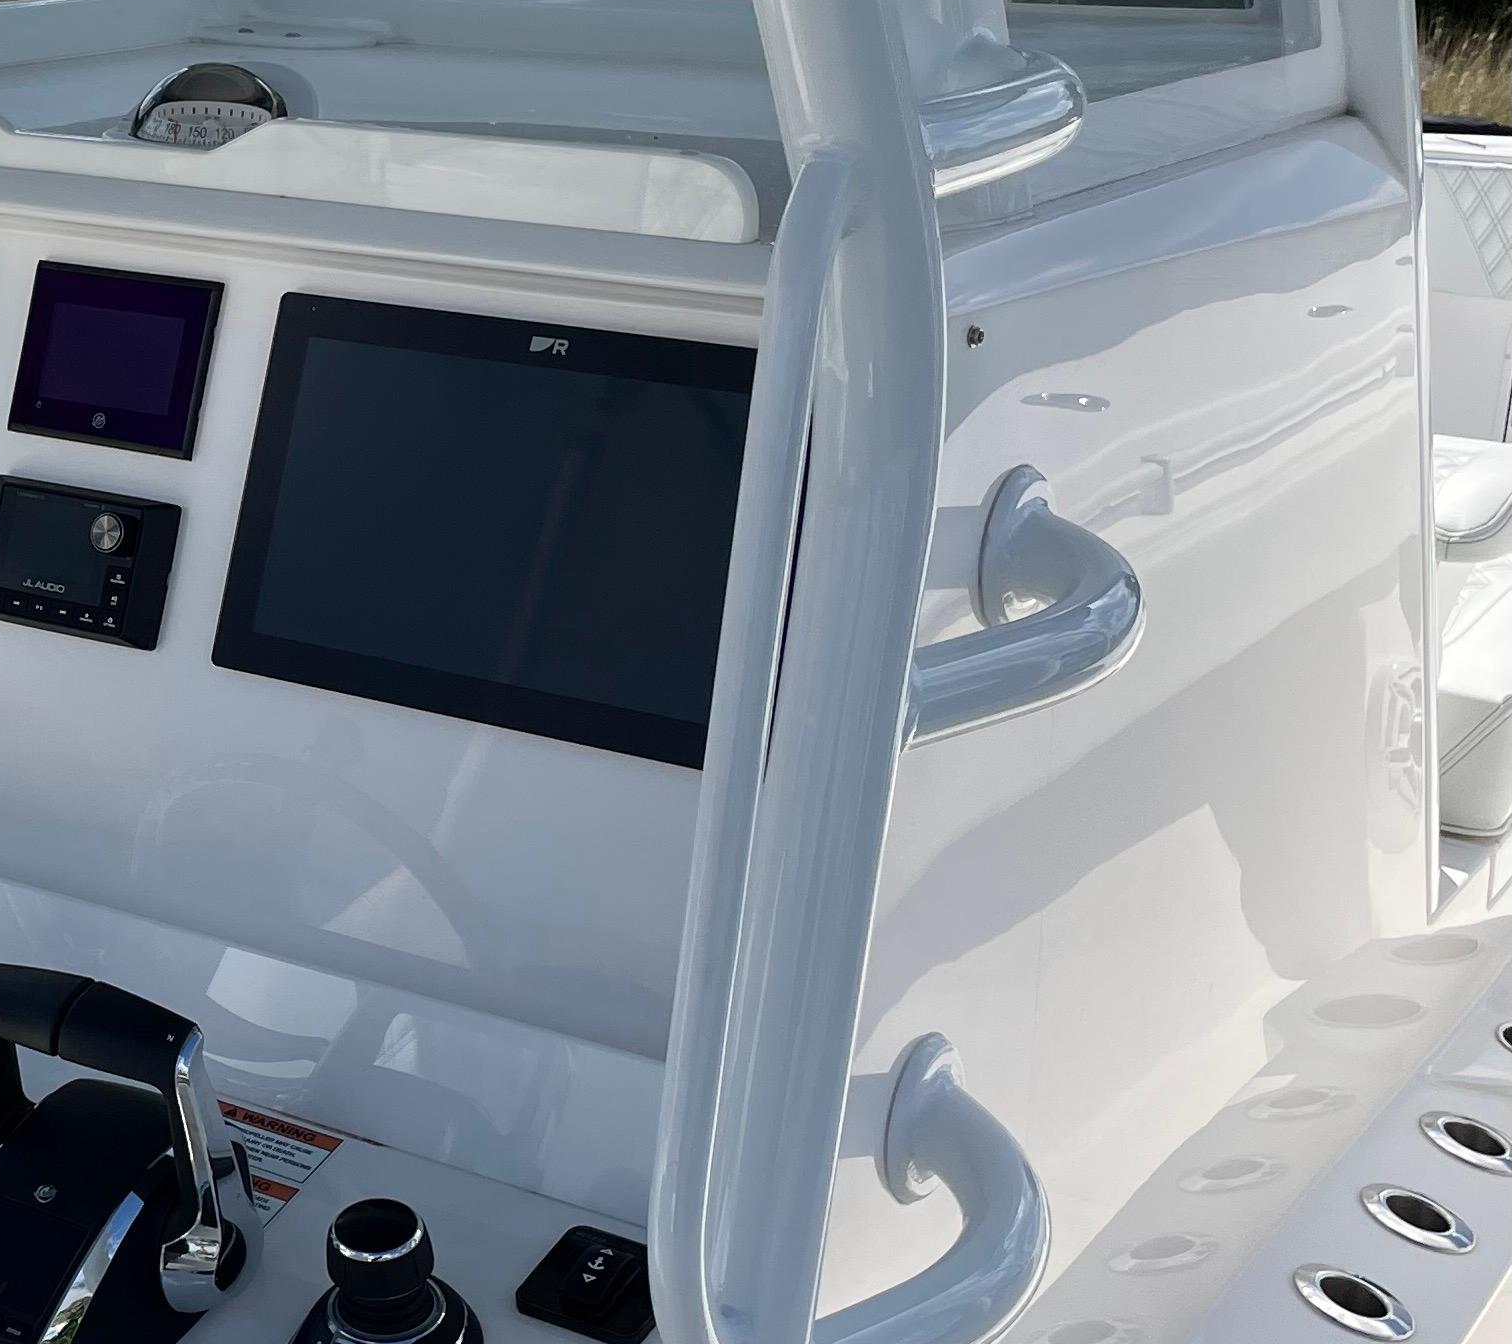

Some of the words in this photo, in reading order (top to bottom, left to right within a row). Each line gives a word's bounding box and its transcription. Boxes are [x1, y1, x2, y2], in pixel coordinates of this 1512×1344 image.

[188, 125, 208, 139] 150
[216, 127, 235, 140] 120
[22, 578, 34, 588] JL
[34, 580, 66, 594] AUDIO
[242, 1110, 317, 1143] WARNING
